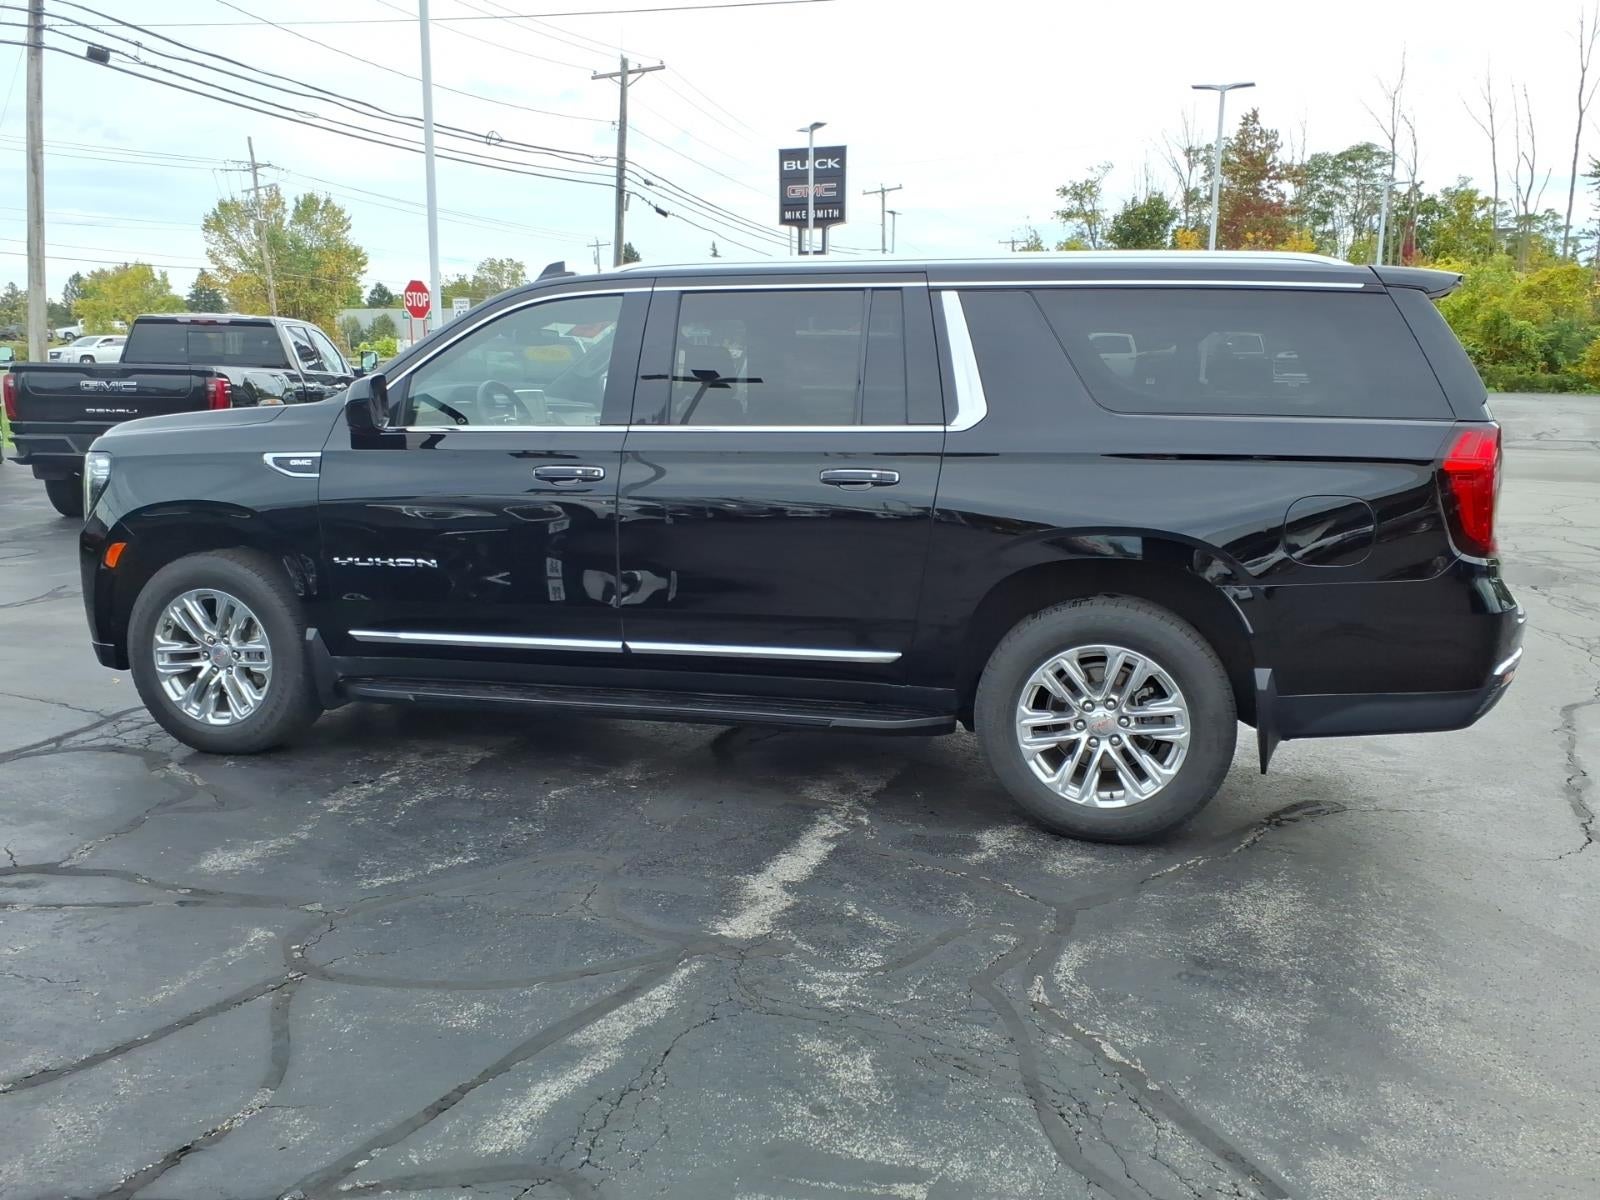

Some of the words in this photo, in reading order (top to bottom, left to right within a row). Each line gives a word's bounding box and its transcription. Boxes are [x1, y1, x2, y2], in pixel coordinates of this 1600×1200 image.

[783, 158, 841, 171] BUCK
[786, 183, 837, 198] GMC
[784, 210, 807, 220] MIKE
[406, 291, 429, 307] STOP
[80, 380, 137, 392] GMC
[333, 557, 438, 568] YUKON
